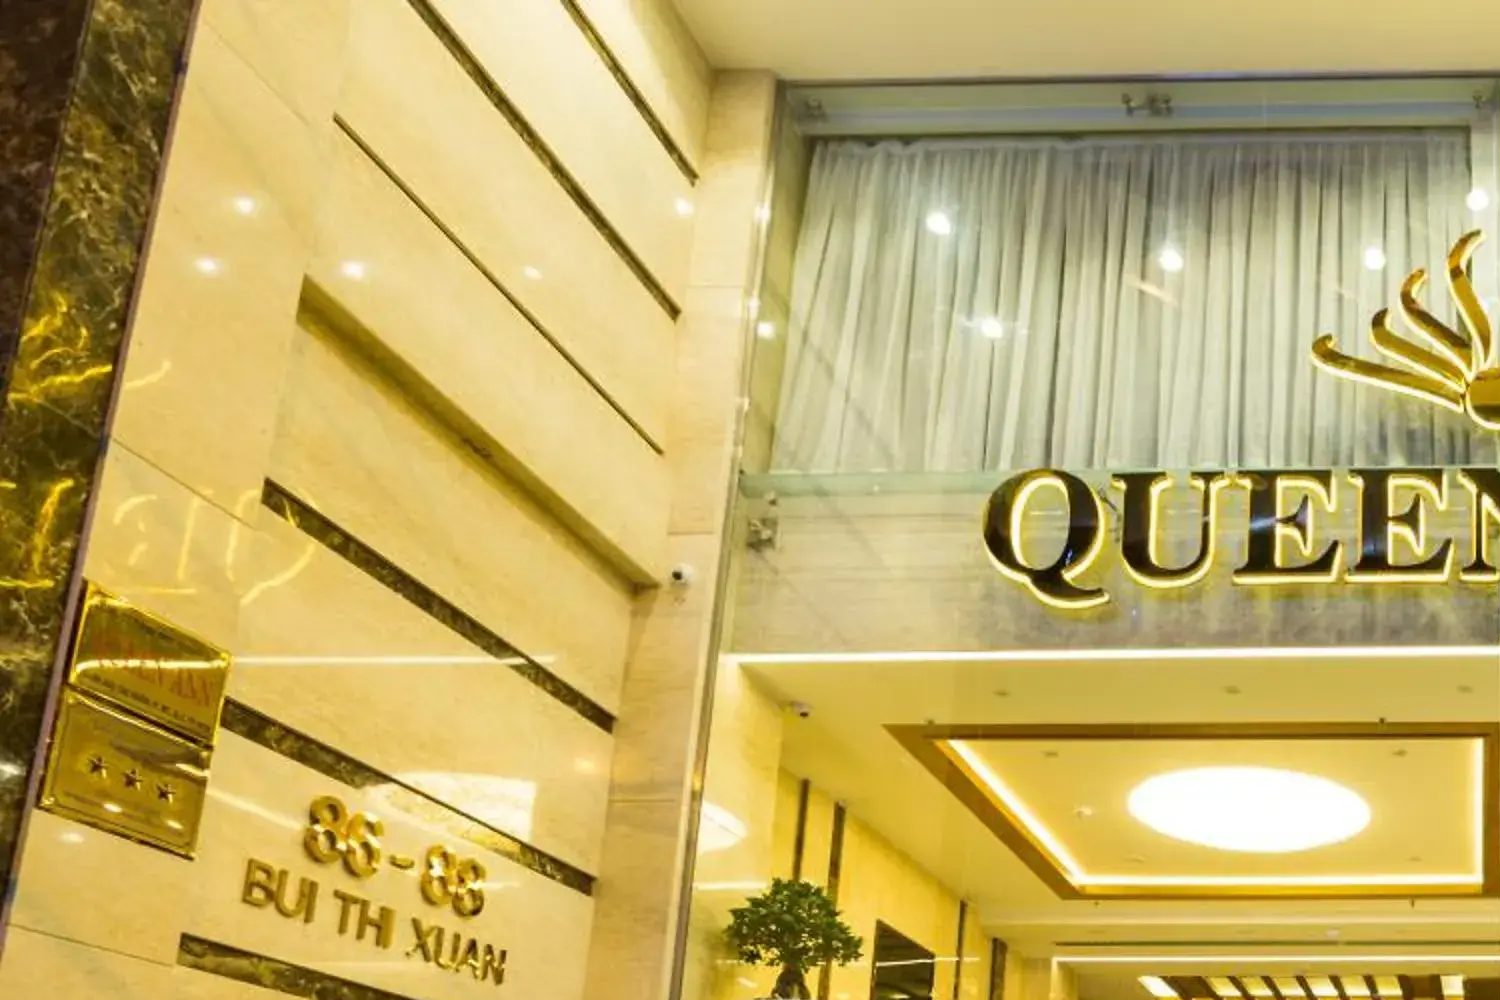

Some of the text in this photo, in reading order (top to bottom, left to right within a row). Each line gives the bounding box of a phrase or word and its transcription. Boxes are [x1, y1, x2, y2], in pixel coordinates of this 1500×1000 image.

[303, 795, 486, 918] 86-88
[241, 857, 507, 986] BUI THI XUAN
